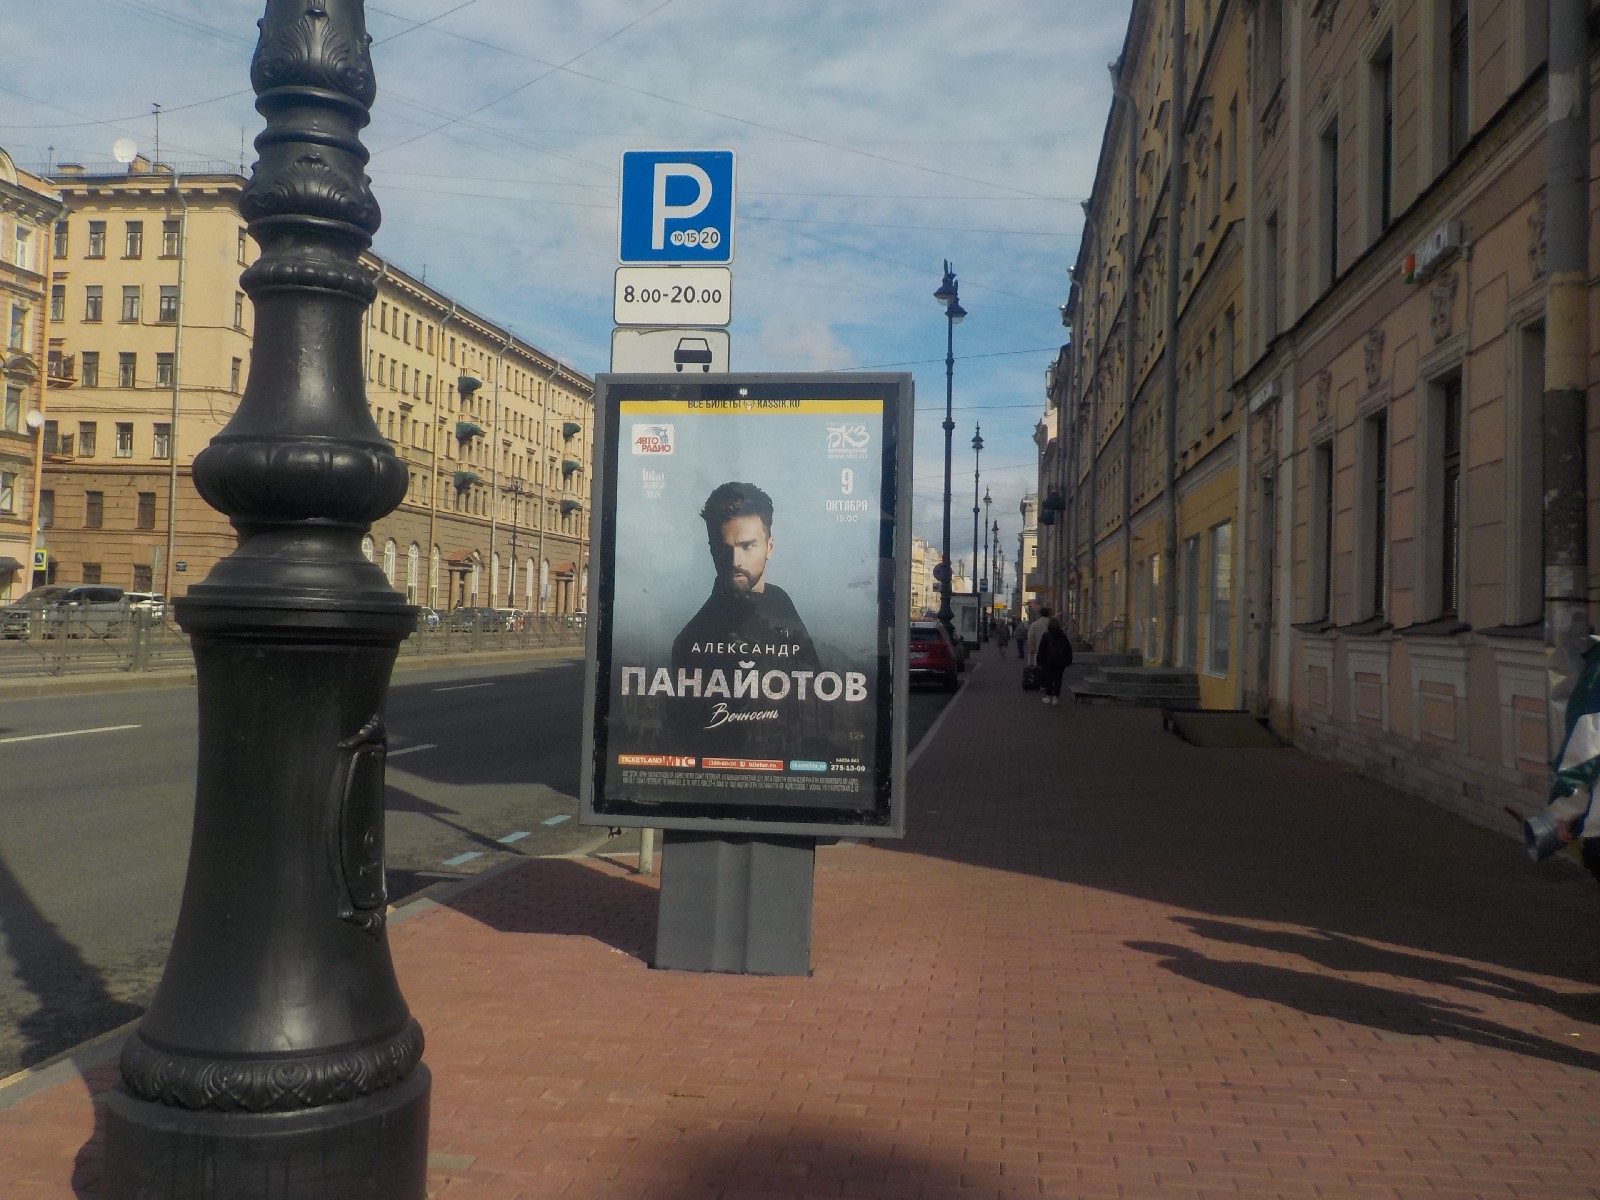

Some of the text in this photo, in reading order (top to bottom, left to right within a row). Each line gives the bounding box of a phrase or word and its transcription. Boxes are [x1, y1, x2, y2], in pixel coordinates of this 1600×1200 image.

[651, 162, 714, 251] P
[701, 231, 719, 244] 20
[623, 284, 723, 304] 8.00-20.00
[634, 436, 659, 445] АВТО
[641, 444, 672, 453] РАДИО
[840, 467, 854, 495] 9
[826, 499, 868, 511] ОКТЯБРЯ
[691, 642, 801, 657] АЛЕКСАНДР
[620, 660, 868, 702] ПАНАЙОТОВ
[703, 702, 779, 729] Вечность
[620, 756, 662, 764] TICKETLAND
